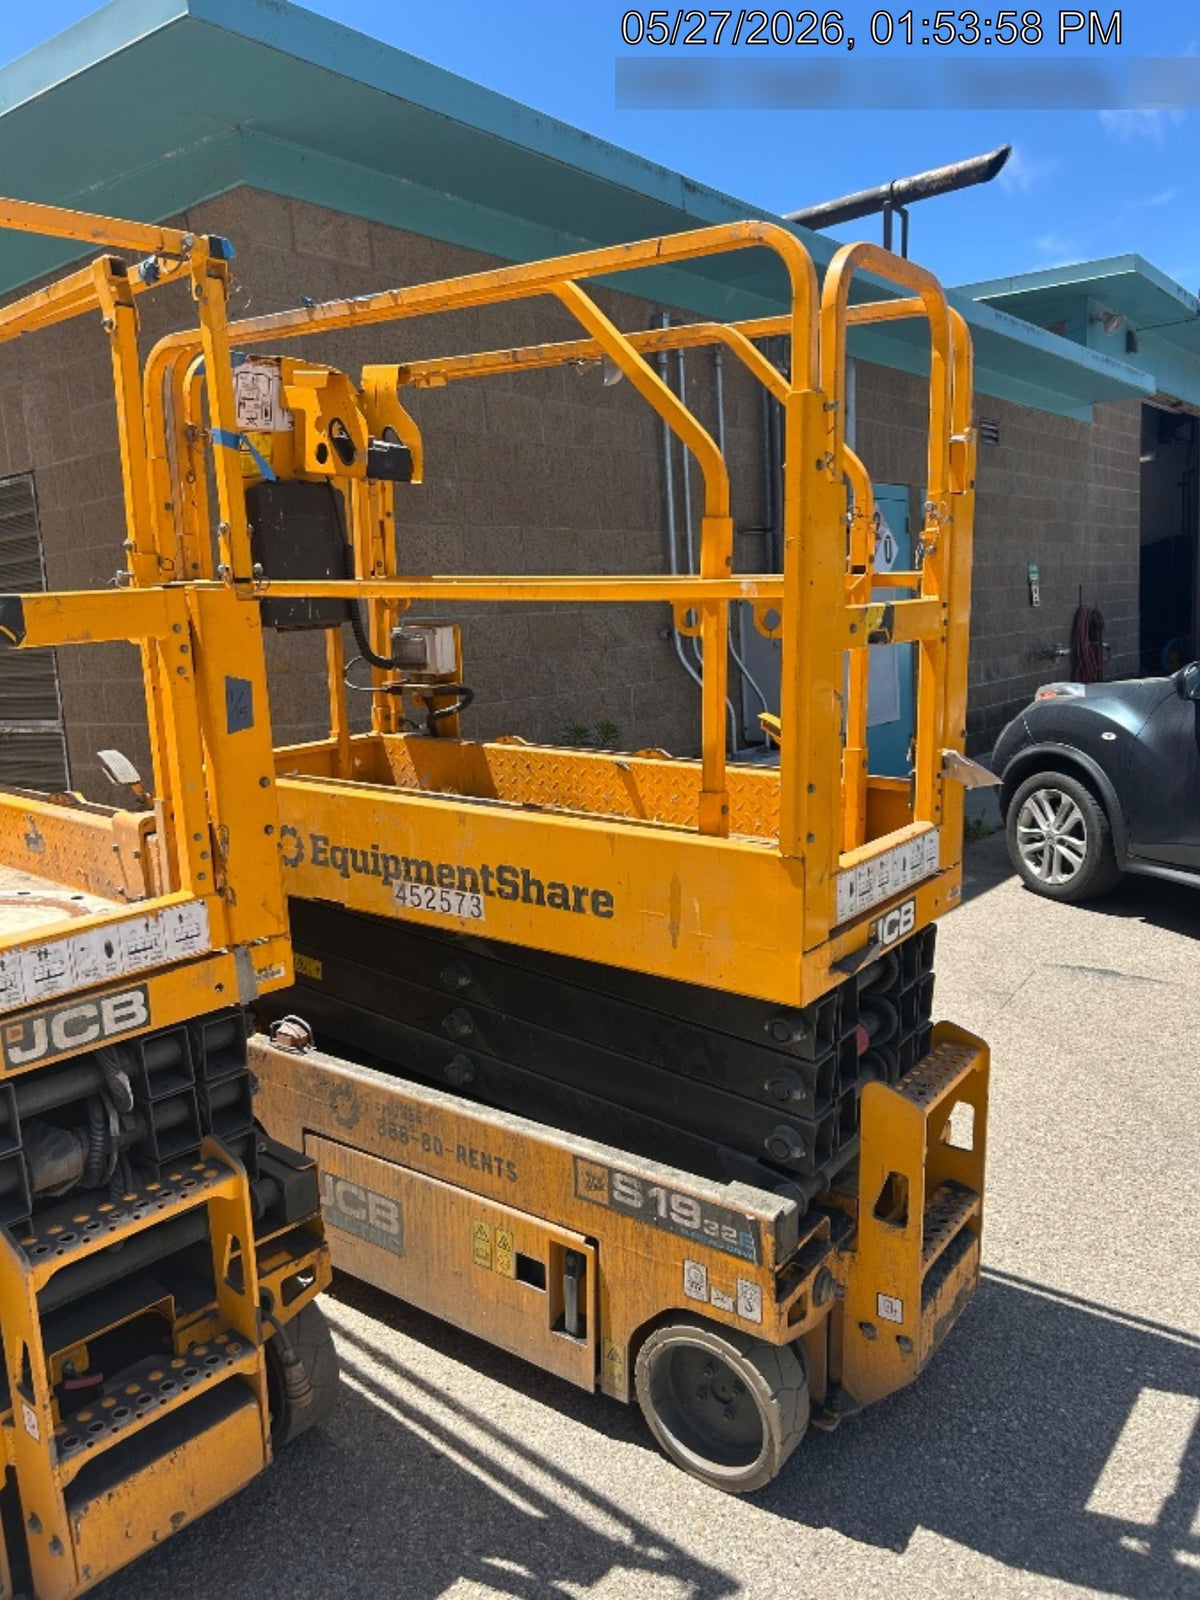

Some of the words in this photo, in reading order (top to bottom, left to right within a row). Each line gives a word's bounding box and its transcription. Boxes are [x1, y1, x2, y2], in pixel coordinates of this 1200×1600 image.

[310, 834, 614, 919] EquipmentShare
[394, 883, 483, 919] 452573
[8, 990, 149, 1064] JCB
[376, 1118, 519, 1182] 888-80-RENTS
[320, 1174, 400, 1235] JCB
